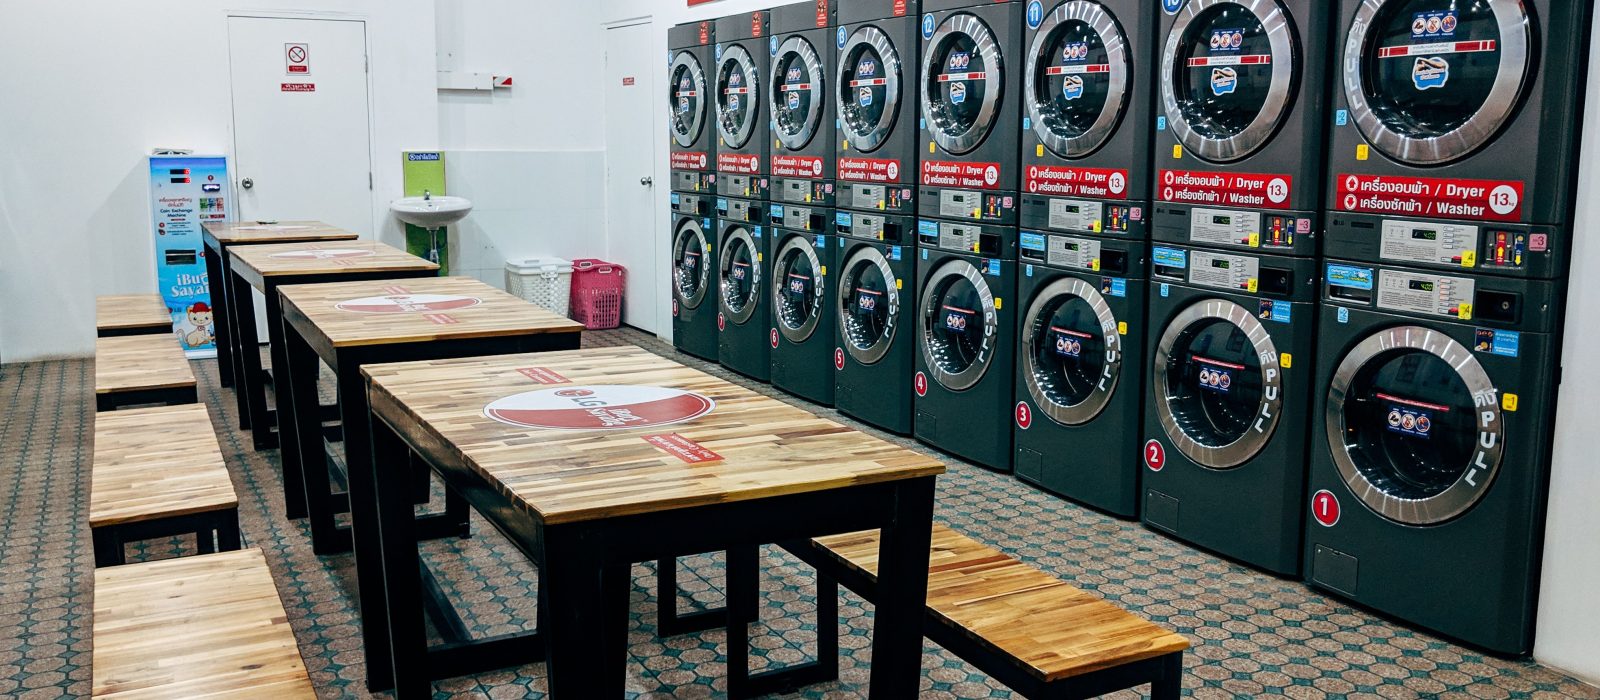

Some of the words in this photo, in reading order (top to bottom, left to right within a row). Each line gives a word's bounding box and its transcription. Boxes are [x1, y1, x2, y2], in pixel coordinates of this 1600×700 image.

[1030, 6, 1038, 21] 11
[924, 18, 932, 32] 12
[1347, 38, 1362, 110] PULL
[966, 166, 983, 176] Dryer
[1085, 172, 1106, 182] Dryer
[963, 178, 984, 186] Washer
[1110, 178, 1120, 188] 13
[1236, 178, 1264, 190] Dryer
[1080, 186, 1107, 195] Washer
[1269, 185, 1282, 196] 13
[1446, 184, 1485, 200] Dryer
[1230, 193, 1264, 204] Washer
[1491, 192, 1509, 206] 13
[1437, 203, 1485, 216] Washer
[1304, 220, 1308, 229] 3
[1538, 236, 1544, 246] 3
[884, 293, 896, 338] PULL
[772, 333, 776, 343] 6
[978, 312, 992, 363] PULL
[837, 353, 842, 364] 5
[1098, 335, 1116, 392] PULL
[918, 377, 924, 390] 4
[571, 396, 607, 407] LG
[1254, 368, 1277, 433] PULL
[1020, 407, 1026, 422] 3
[1150, 446, 1158, 463] 2
[1466, 412, 1496, 488] PULL
[1320, 498, 1327, 515] 1
